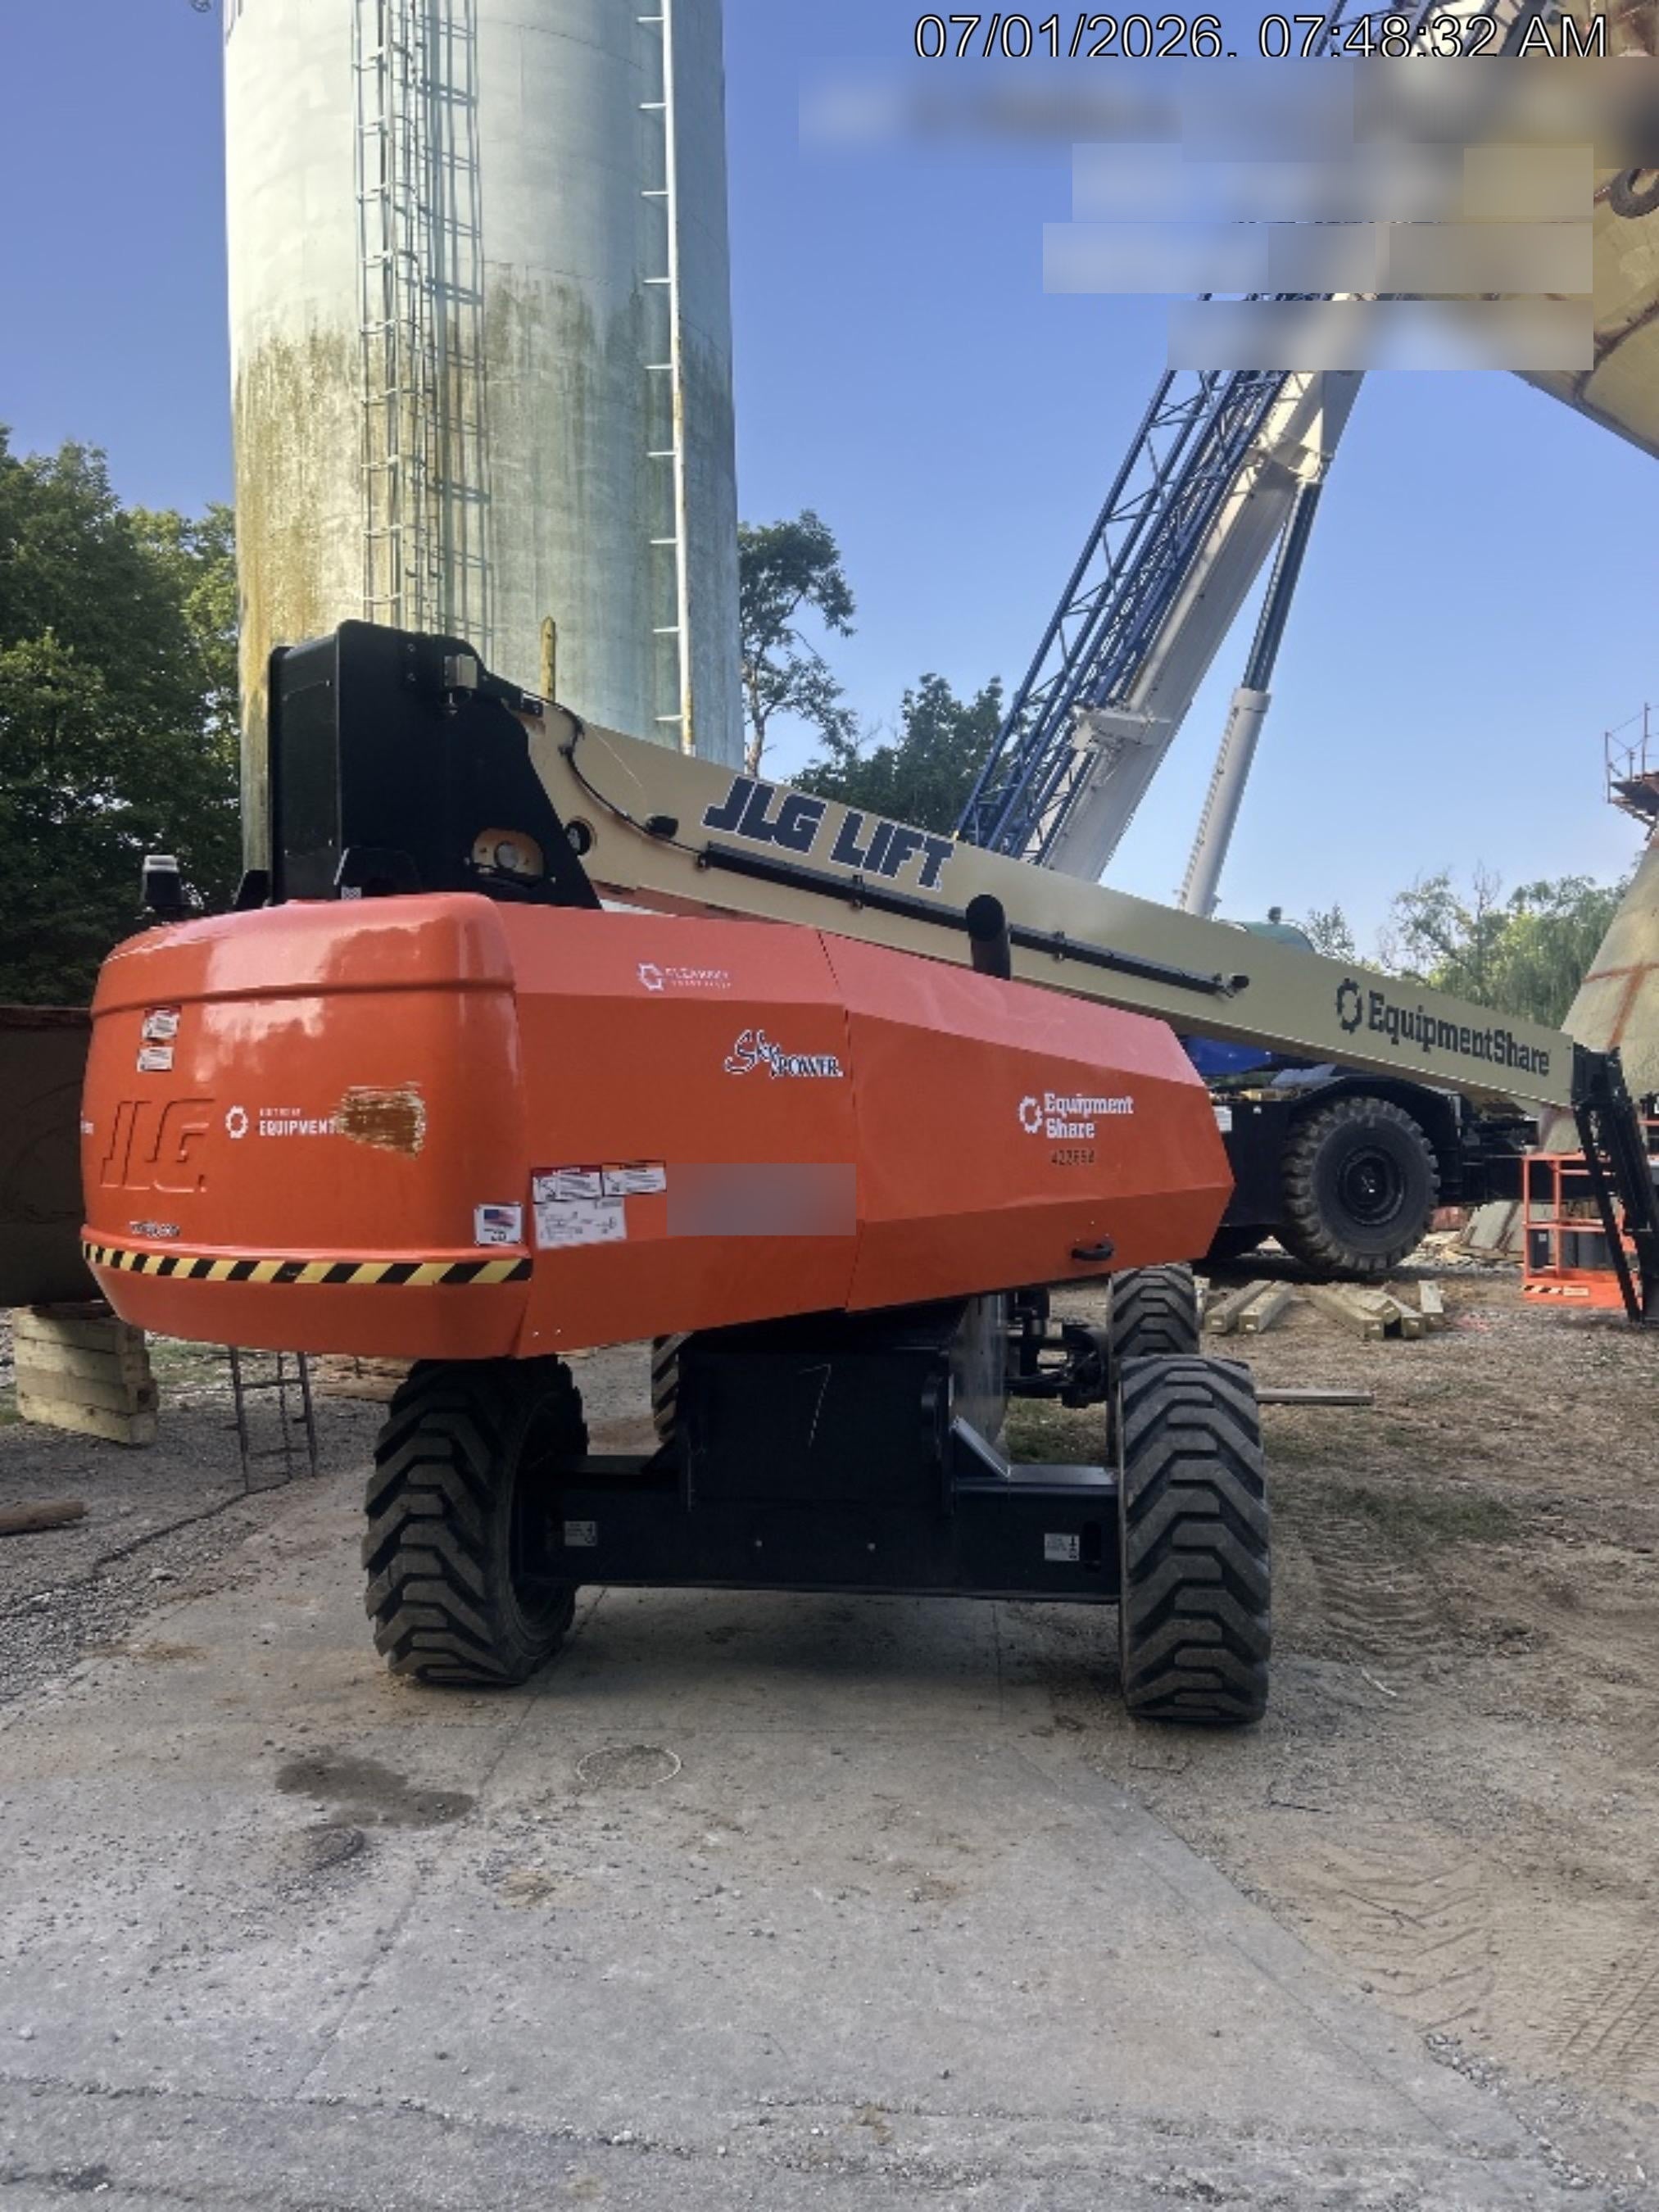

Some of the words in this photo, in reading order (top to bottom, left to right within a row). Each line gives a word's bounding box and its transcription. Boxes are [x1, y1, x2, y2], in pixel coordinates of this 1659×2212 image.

[701, 774, 827, 854] JLG
[830, 806, 957, 891] LIFT
[1368, 989, 1551, 1077] EquipmentShare
[1044, 1092, 1135, 1118] Equipment
[1046, 1117, 1095, 1139] Share
